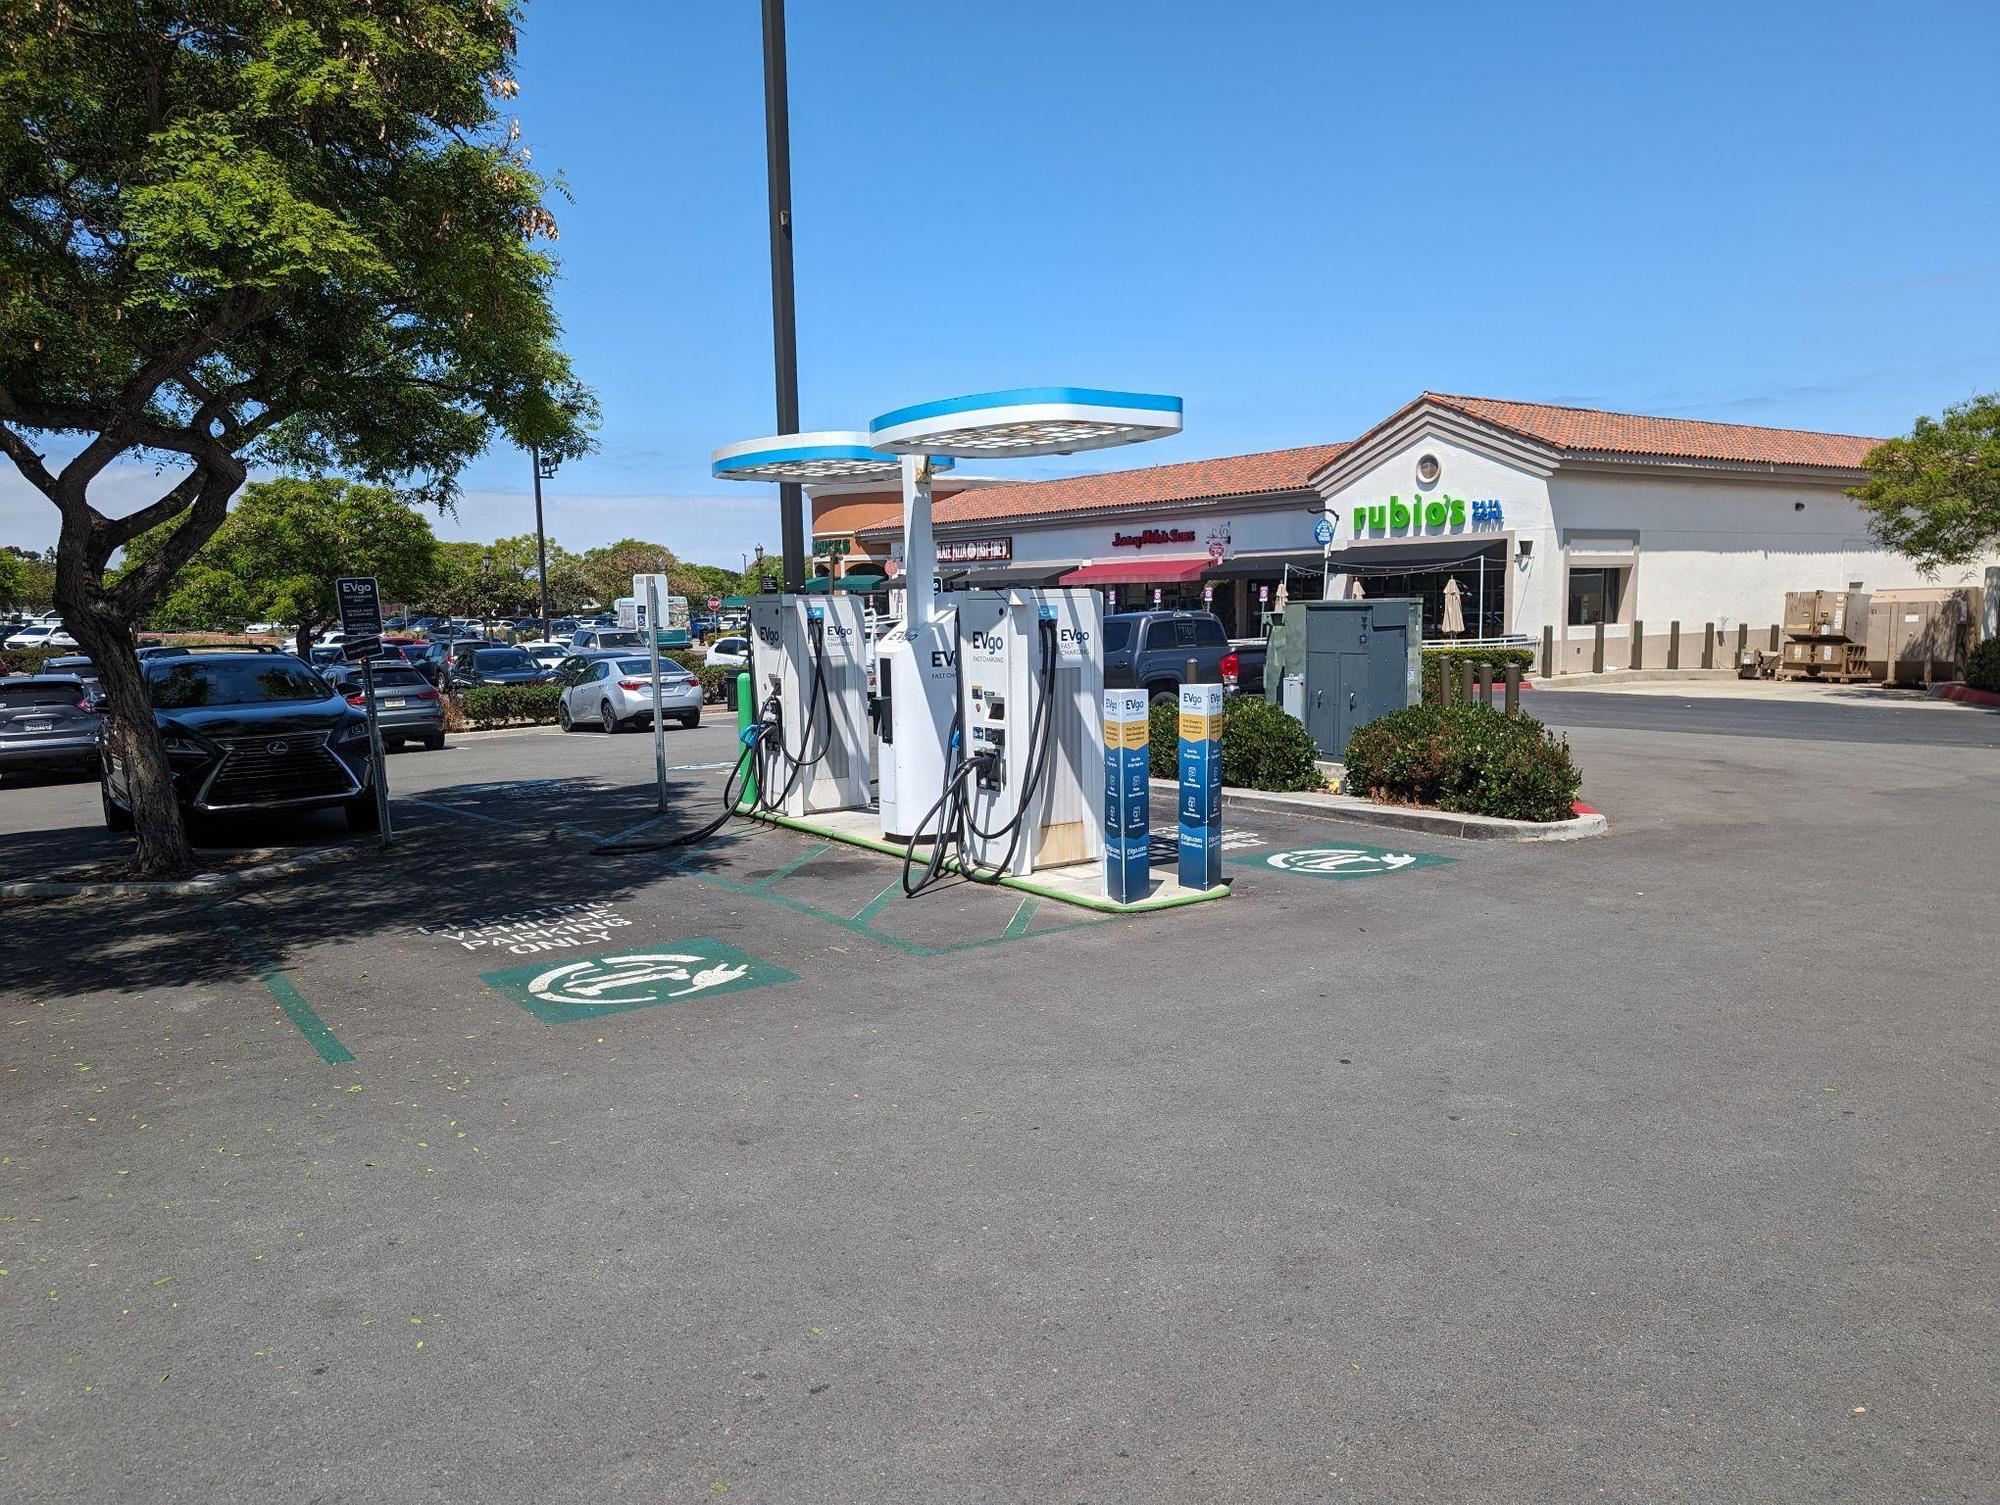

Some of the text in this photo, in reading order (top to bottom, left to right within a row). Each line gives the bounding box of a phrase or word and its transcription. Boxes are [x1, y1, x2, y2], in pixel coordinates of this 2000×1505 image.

[1354, 494, 1466, 530] rubio's
[343, 583, 371, 594] EVgo
[760, 627, 779, 644] EVgo
[827, 626, 852, 637] EVgo
[889, 631, 918, 642] EVgo
[1061, 629, 1089, 644] EVgo
[973, 631, 1003, 655] EVgo
[931, 651, 956, 668] EV
[1106, 698, 1117, 711] EVgo
[1126, 700, 1144, 711] EVgo
[1184, 693, 1201, 705] EVgo
[1181, 834, 1202, 844] EVgo.com
[1127, 846, 1146, 856] EVgo.com
[417, 900, 614, 935] ELECTRIC
[441, 909, 619, 941] VEHICLE
[461, 918, 633, 950] PARKING
[508, 930, 612, 954] ONLY
